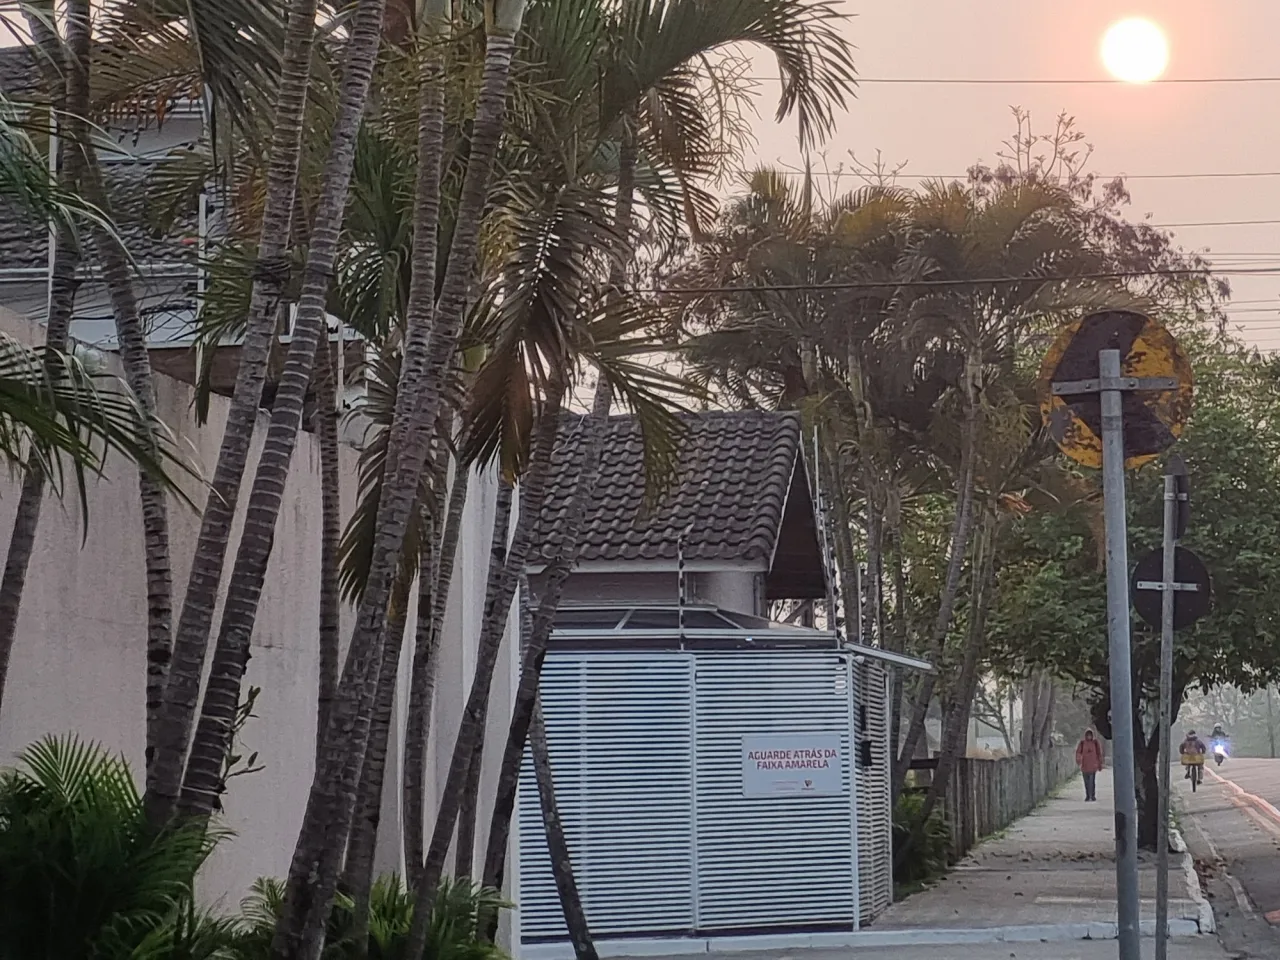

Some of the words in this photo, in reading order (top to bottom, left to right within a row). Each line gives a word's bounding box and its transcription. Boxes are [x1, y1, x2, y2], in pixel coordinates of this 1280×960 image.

[748, 750, 792, 760] AGUARDE
[793, 748, 822, 759] ATRÁS
[824, 749, 837, 758] DA
[757, 760, 783, 770] FAIXA
[784, 759, 829, 769] AMARELA
